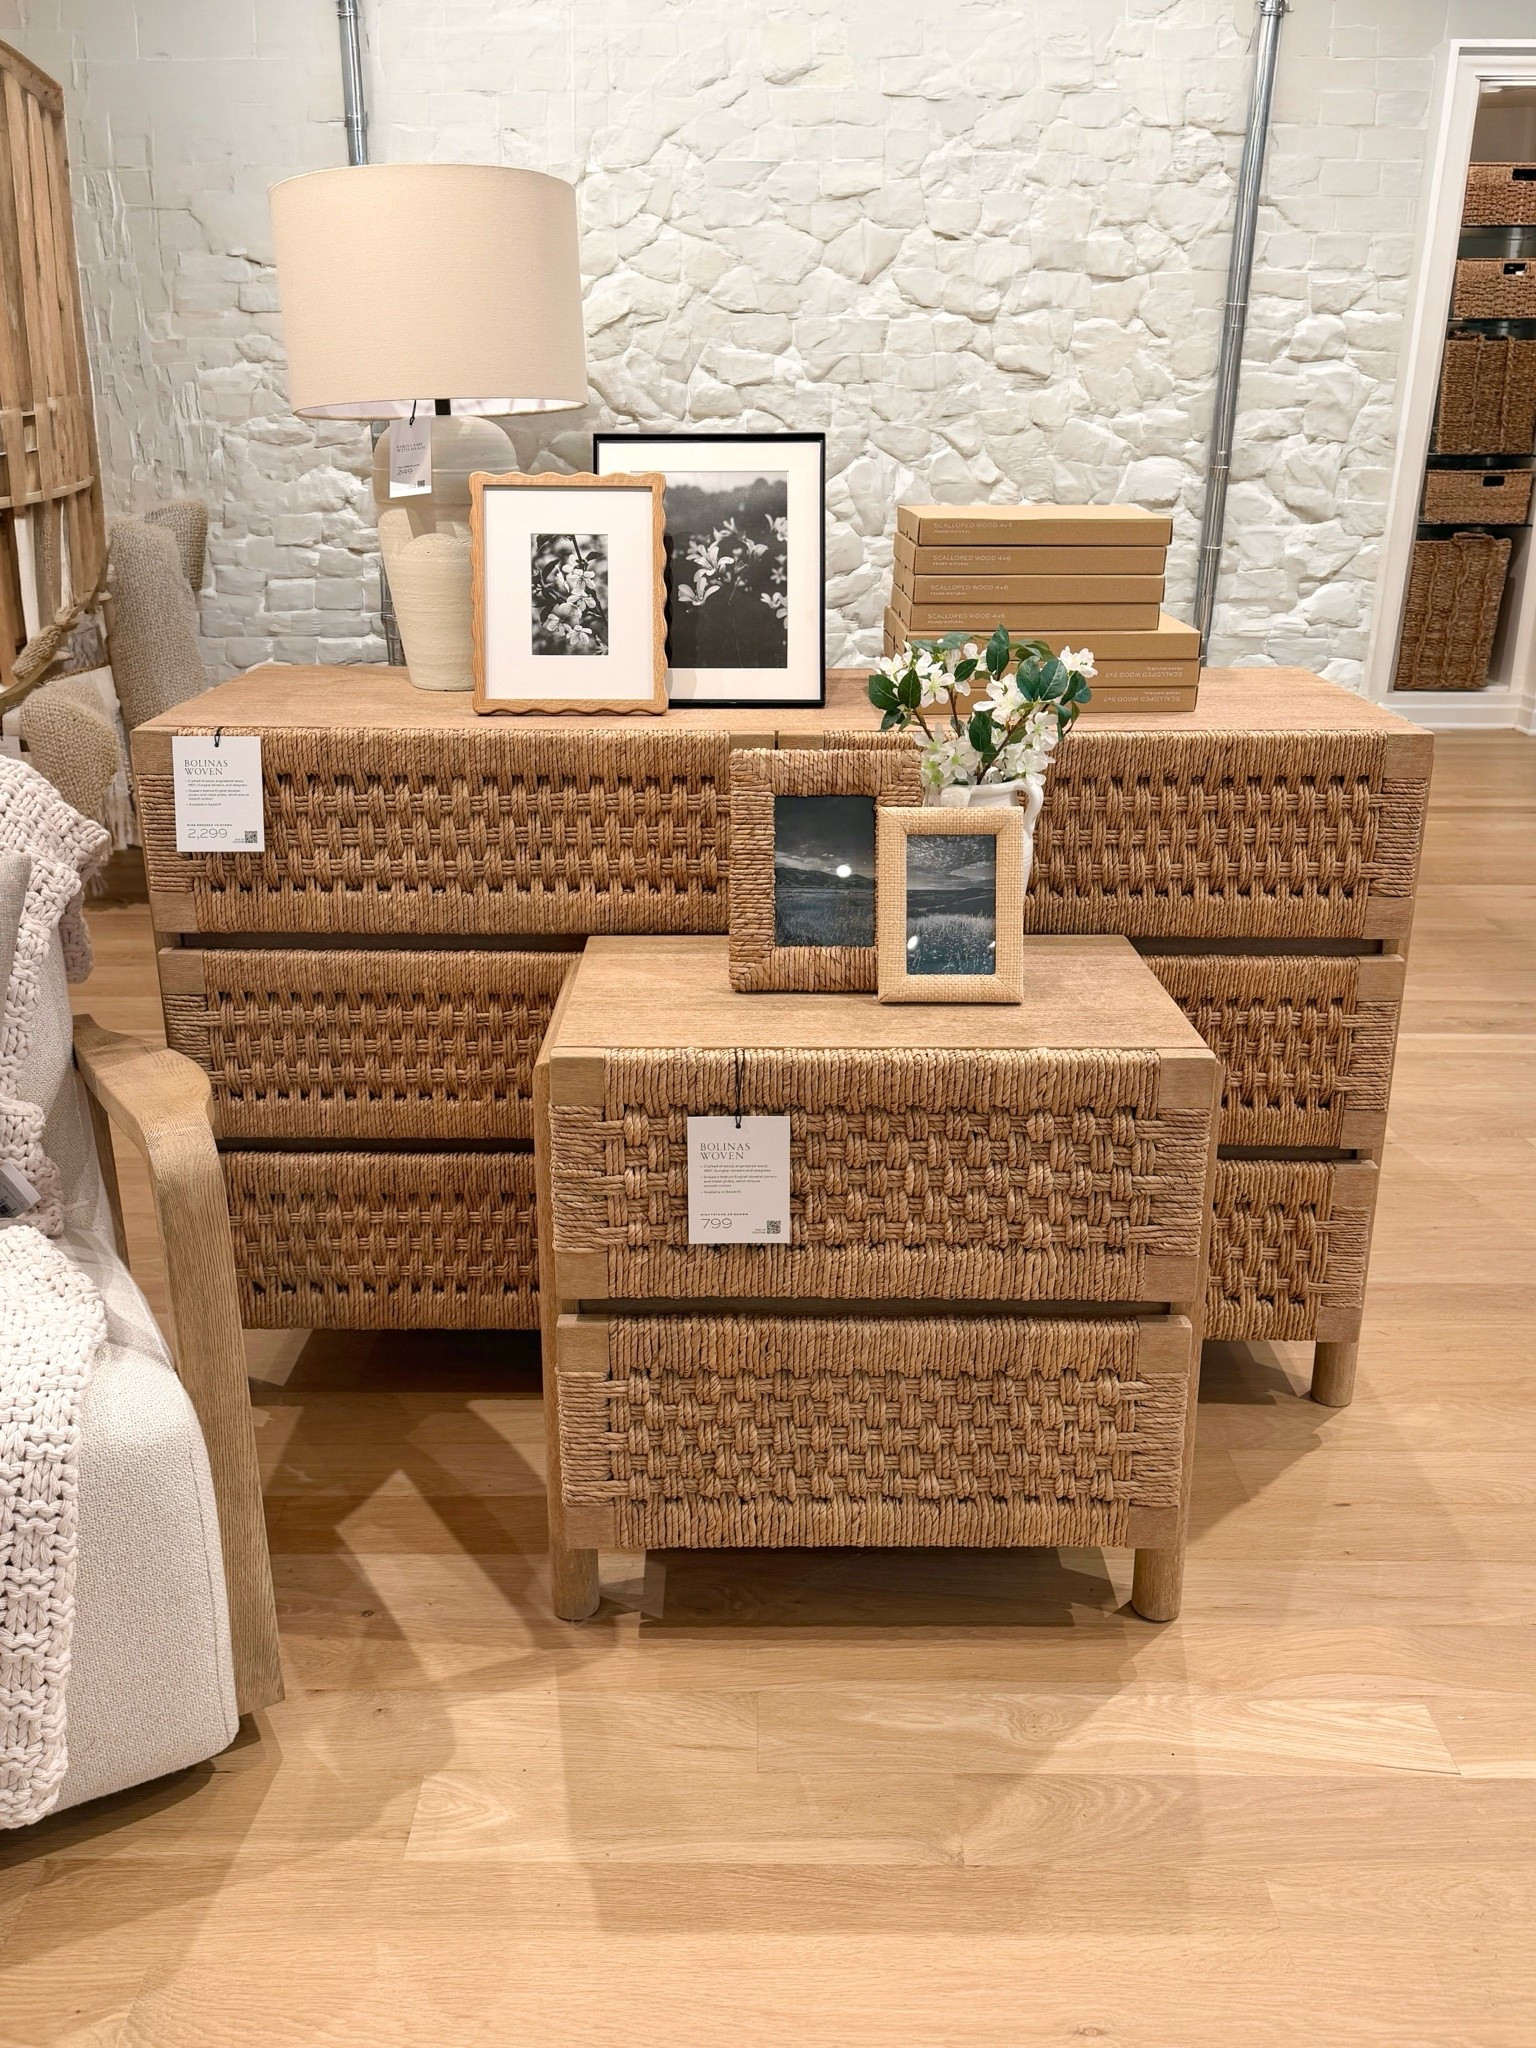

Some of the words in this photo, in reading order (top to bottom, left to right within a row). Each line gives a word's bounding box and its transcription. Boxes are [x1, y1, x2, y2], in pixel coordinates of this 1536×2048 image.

[184, 759, 228, 768] BOLINAS
[184, 768, 223, 776] WOVEN
[187, 828, 228, 840] 2,299
[700, 1142, 751, 1151] BOLINAS
[700, 1152, 744, 1160] WOVEN
[700, 1217, 733, 1229] 799
